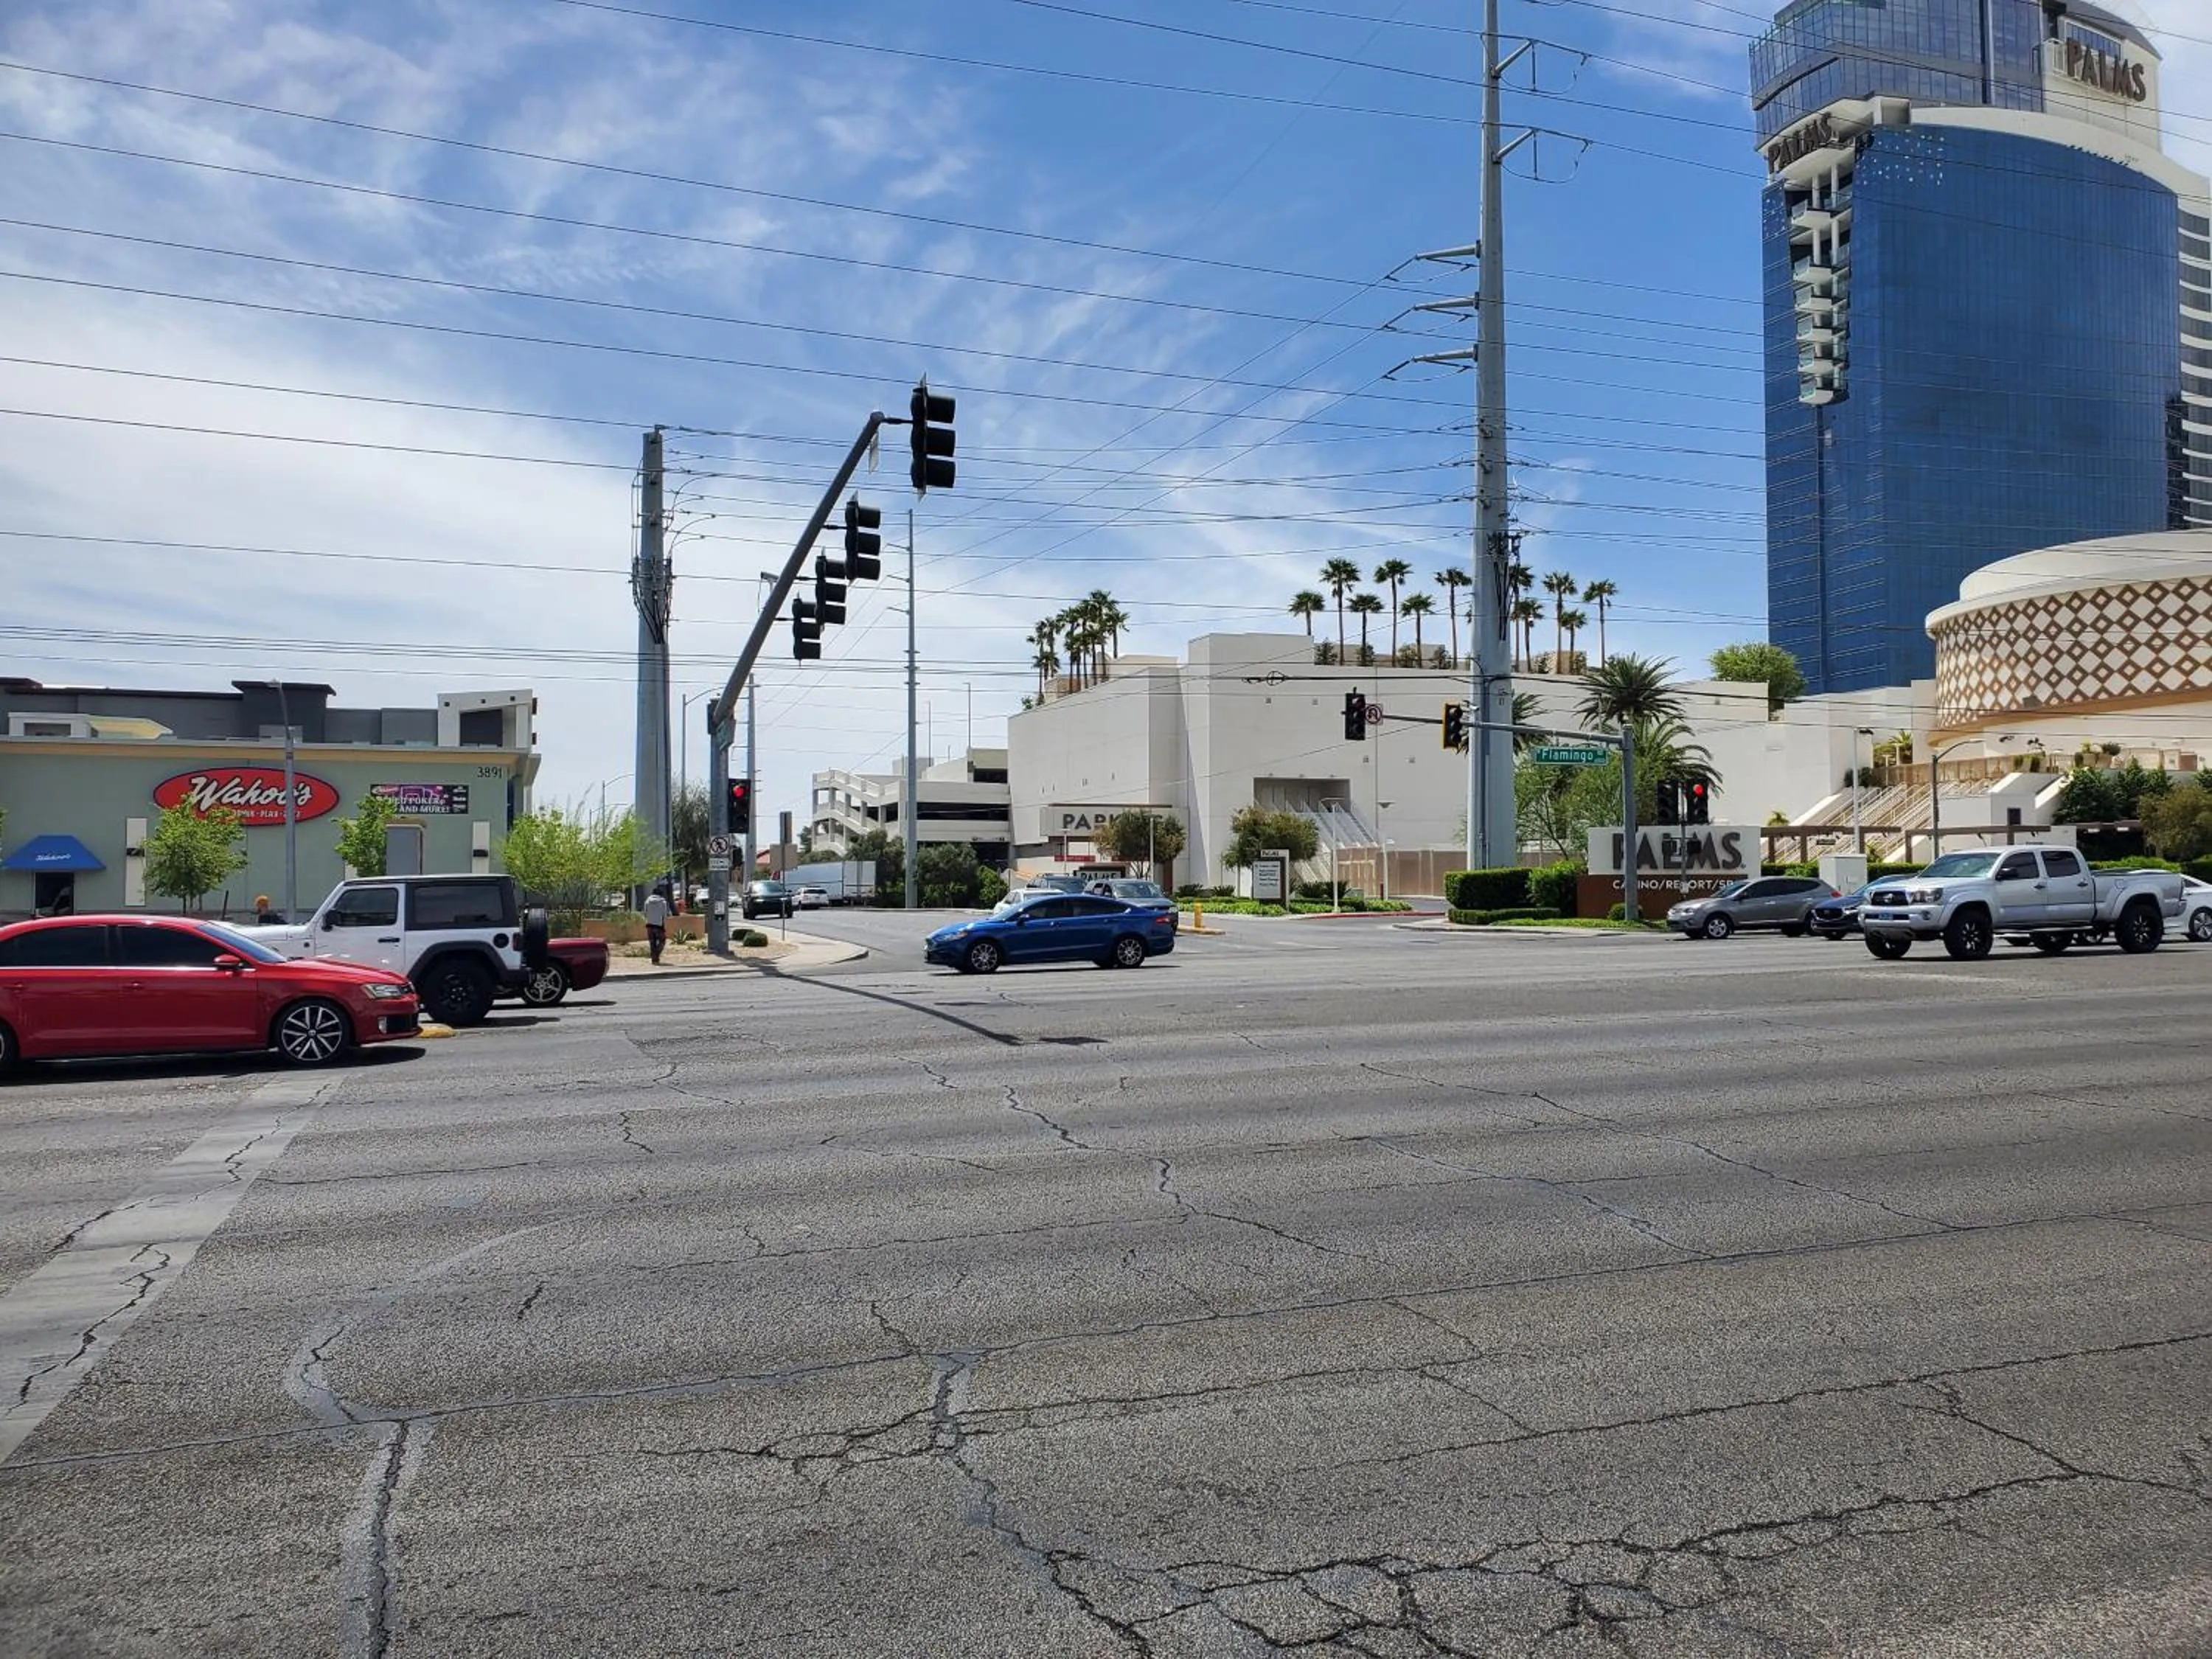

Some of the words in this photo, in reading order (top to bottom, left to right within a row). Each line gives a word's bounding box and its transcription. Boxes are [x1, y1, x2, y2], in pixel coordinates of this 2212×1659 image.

[2067, 37, 2146, 102] PALMS
[1768, 112, 1832, 174] PALMS
[477, 766, 502, 779] 3891
[1541, 748, 1593, 764] Flamingo
[190, 776, 313, 812] Wahoo's
